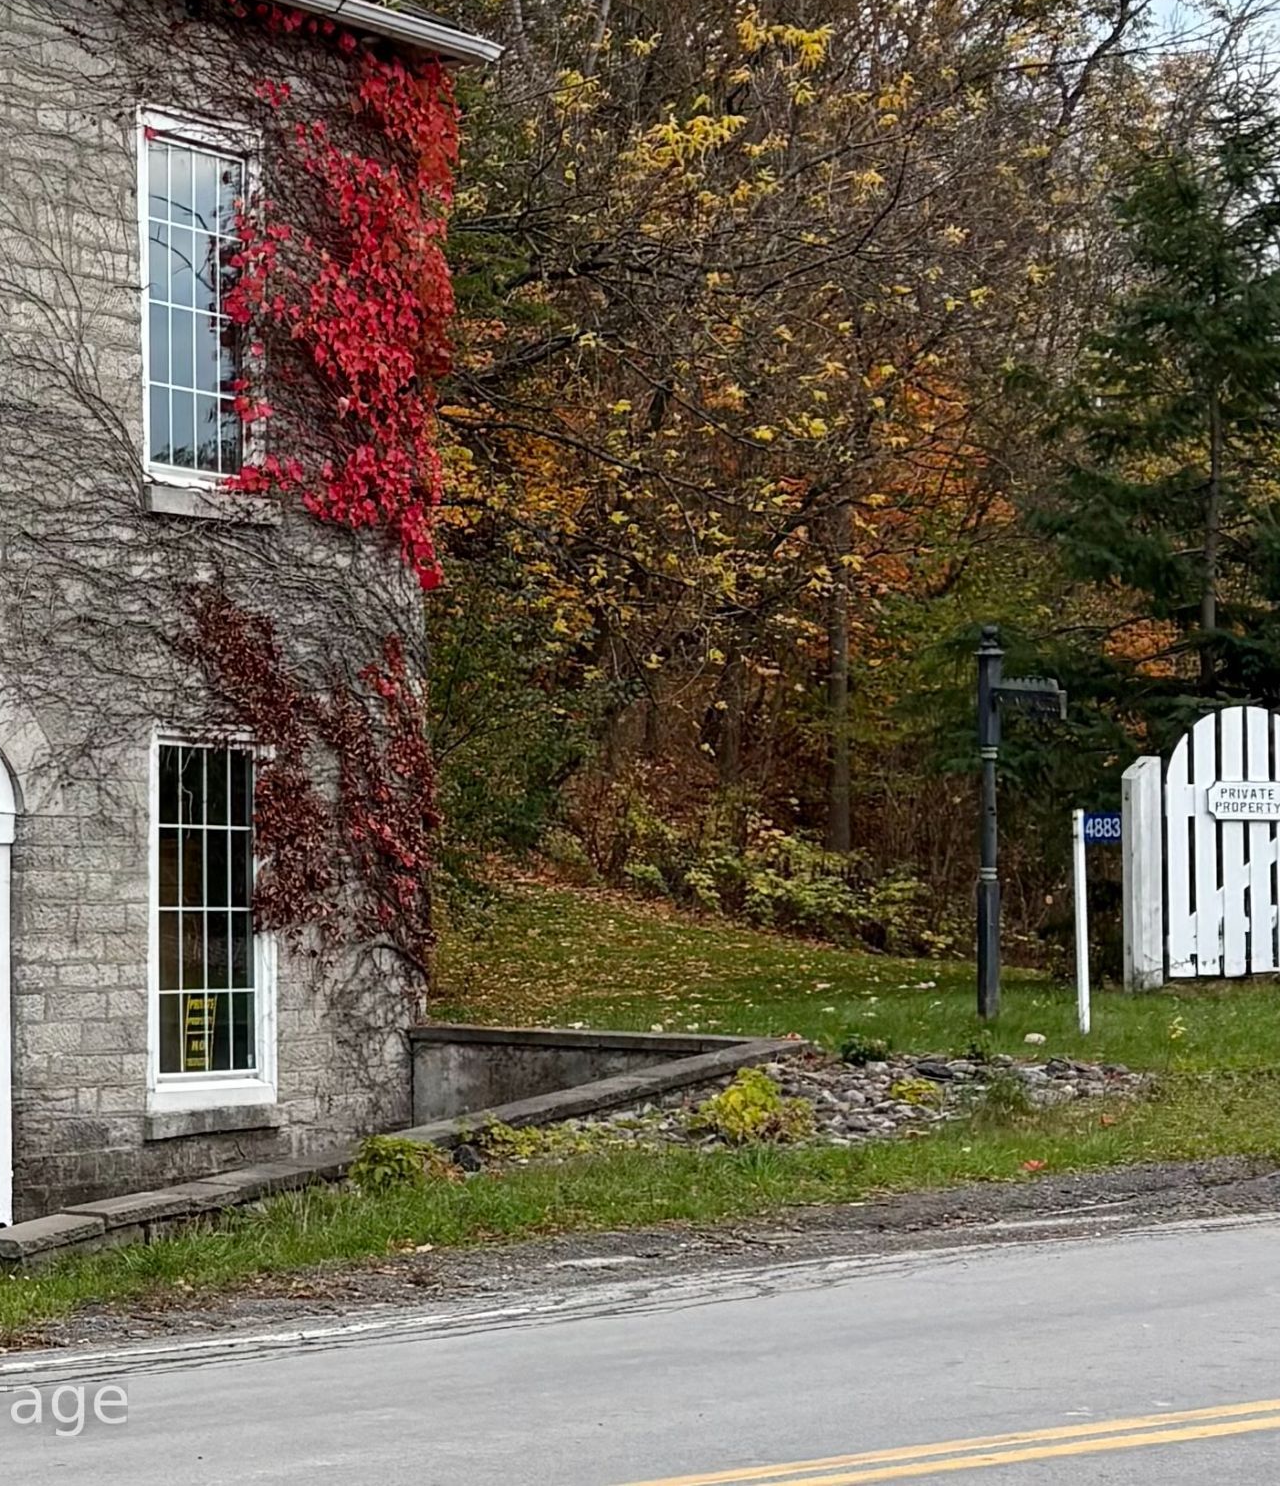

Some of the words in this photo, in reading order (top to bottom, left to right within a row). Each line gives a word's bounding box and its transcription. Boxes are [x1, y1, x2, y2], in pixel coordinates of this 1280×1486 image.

[1220, 787, 1275, 800] PRIVATE
[1215, 801, 1280, 814] PROPERTY
[1085, 817, 1121, 838] 4883
